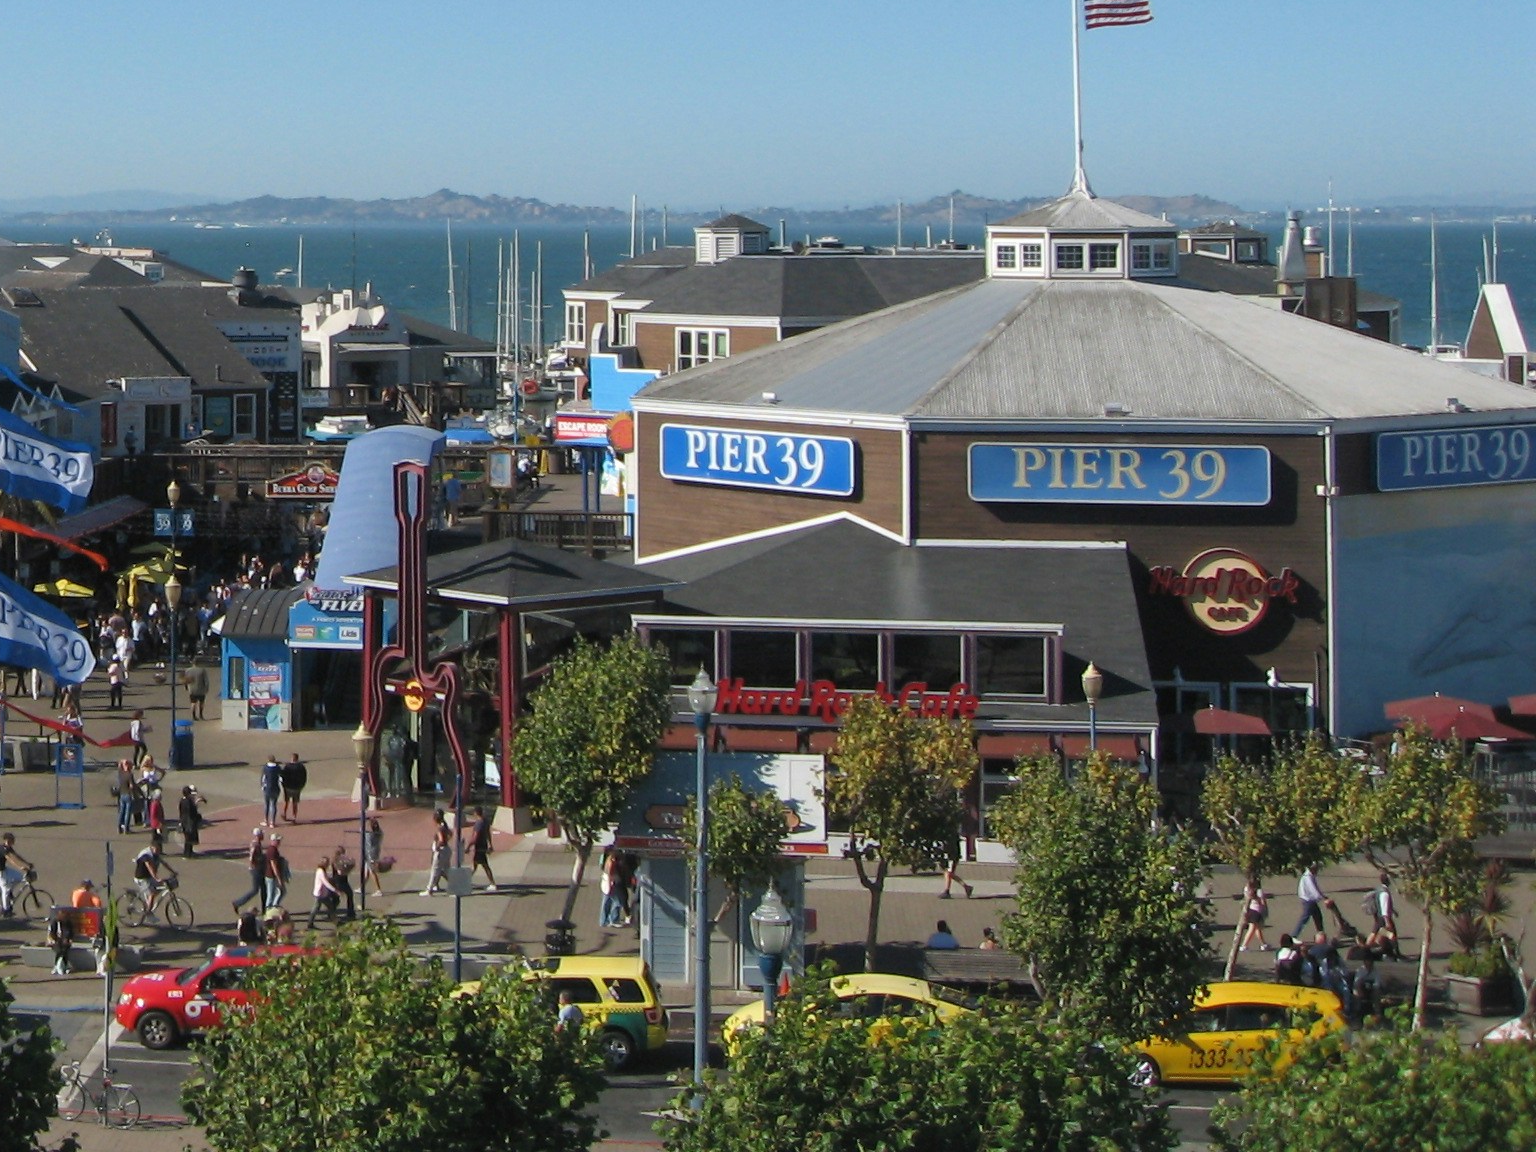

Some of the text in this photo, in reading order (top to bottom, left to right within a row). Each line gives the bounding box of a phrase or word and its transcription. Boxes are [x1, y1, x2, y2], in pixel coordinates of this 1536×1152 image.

[47, 452, 80, 483] 39
[685, 430, 825, 488] PIER 39
[1012, 448, 1227, 499] PIER 39
[1402, 429, 1530, 479] PIER 39
[321, 600, 364, 611] FLYE
[1148, 565, 1299, 604] Hard Rock
[52, 633, 87, 673] 39
[716, 677, 979, 724] Hard Rok Cafe
